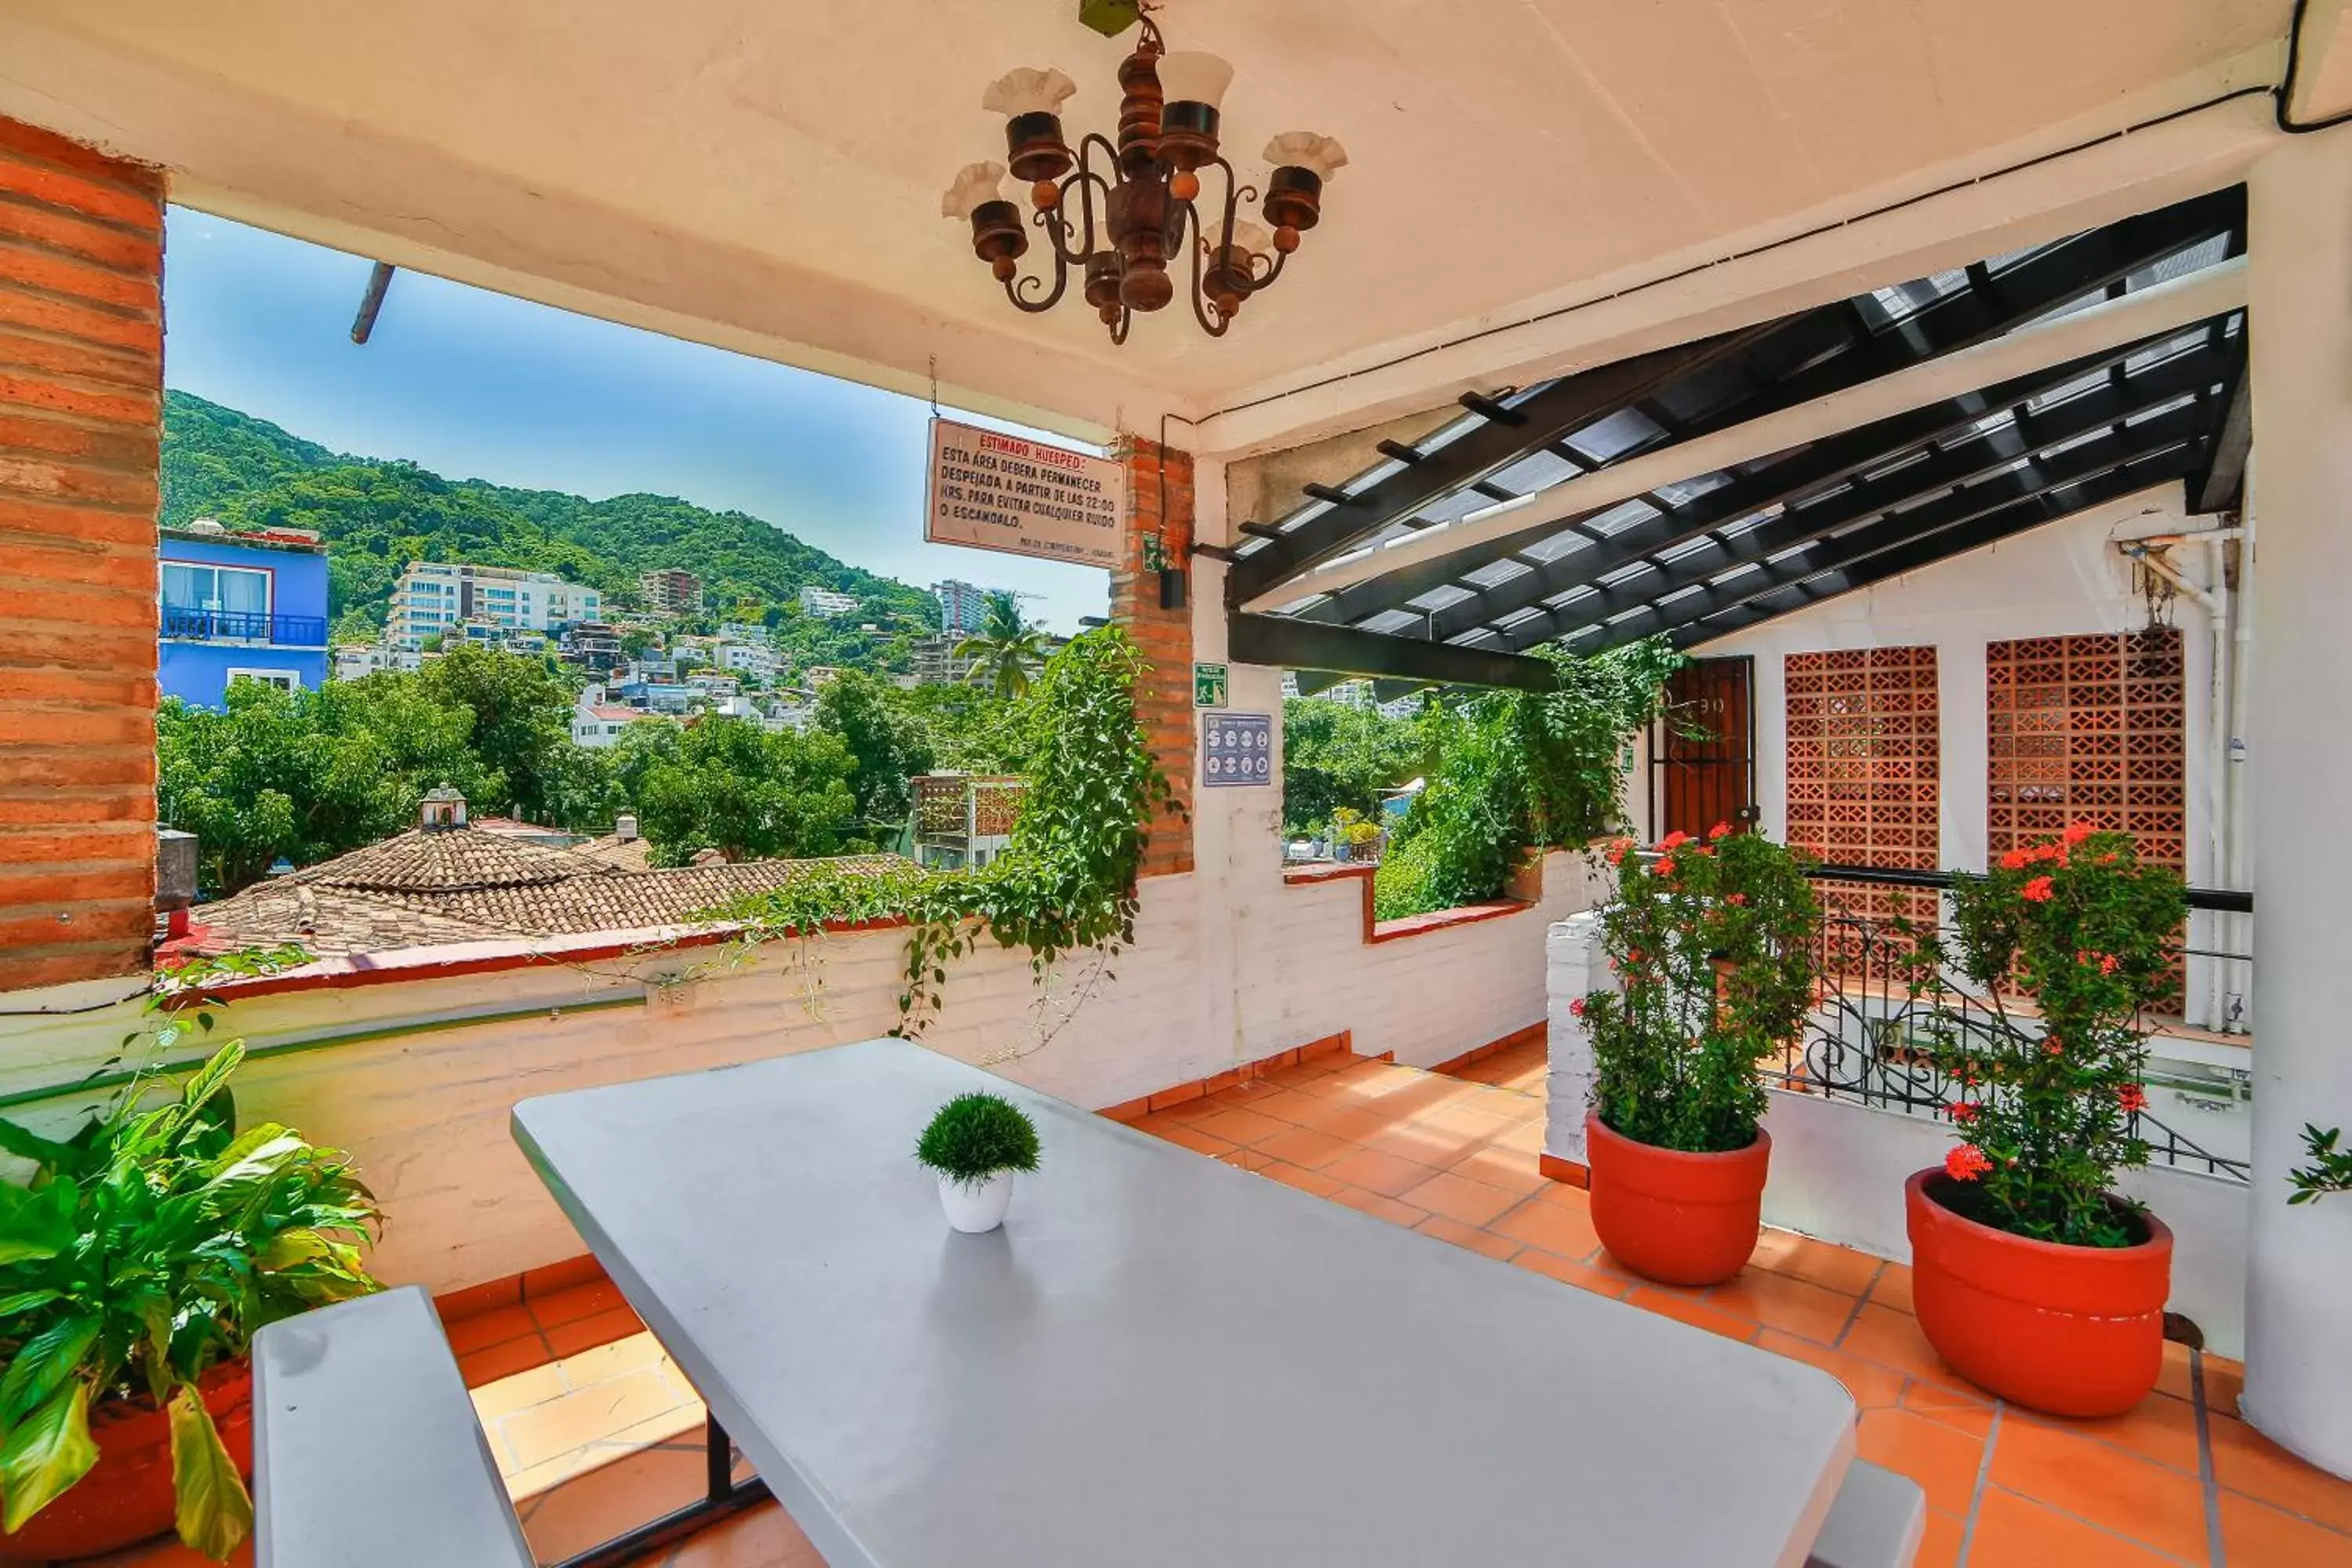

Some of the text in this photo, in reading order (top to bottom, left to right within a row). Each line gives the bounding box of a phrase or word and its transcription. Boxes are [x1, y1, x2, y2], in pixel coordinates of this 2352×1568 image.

[942, 446, 969, 464] ESTA
[1001, 459, 1037, 479] DEBERA
[1041, 469, 1102, 493] PERMANECER
[980, 434, 1086, 469] ESTIMADO HUESPED:
[942, 466, 1115, 512] DESPEJADA A PARTIR DE LAS 22:00
[942, 485, 1115, 528] HRS. PARA EVITAR CUALQUIER RUIDO
[941, 503, 1023, 528] O ESCANDALO.
